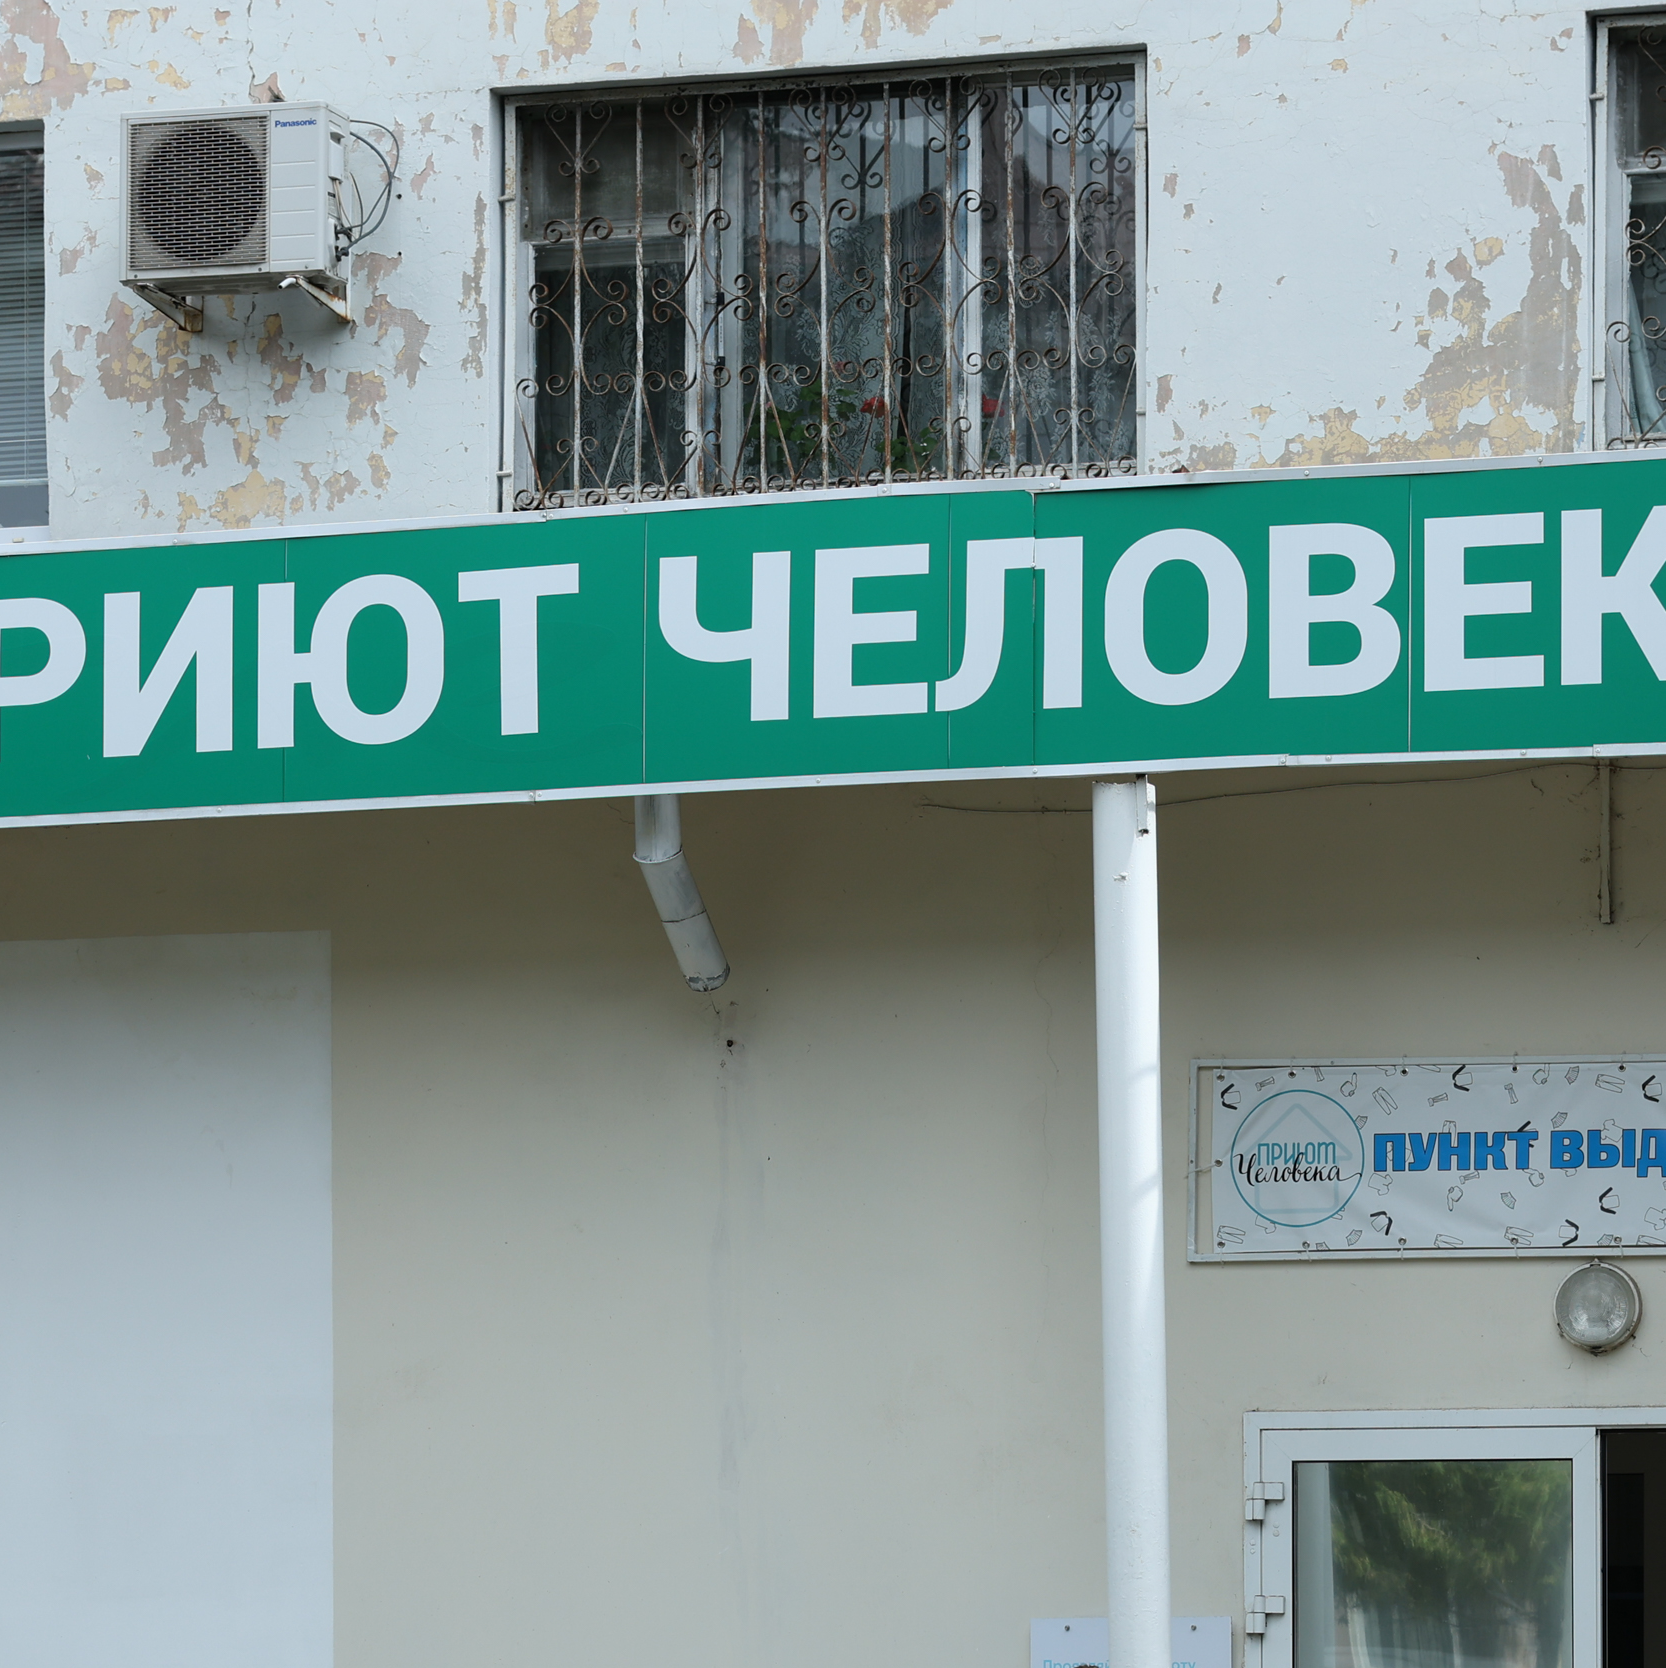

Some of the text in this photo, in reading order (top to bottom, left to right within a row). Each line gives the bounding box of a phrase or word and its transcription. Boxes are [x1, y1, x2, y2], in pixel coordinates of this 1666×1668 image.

[274, 117, 318, 128] Panasonic
[1373, 1130, 1539, 1172] ПУНКТ
[1233, 1152, 1362, 1187] Человека
